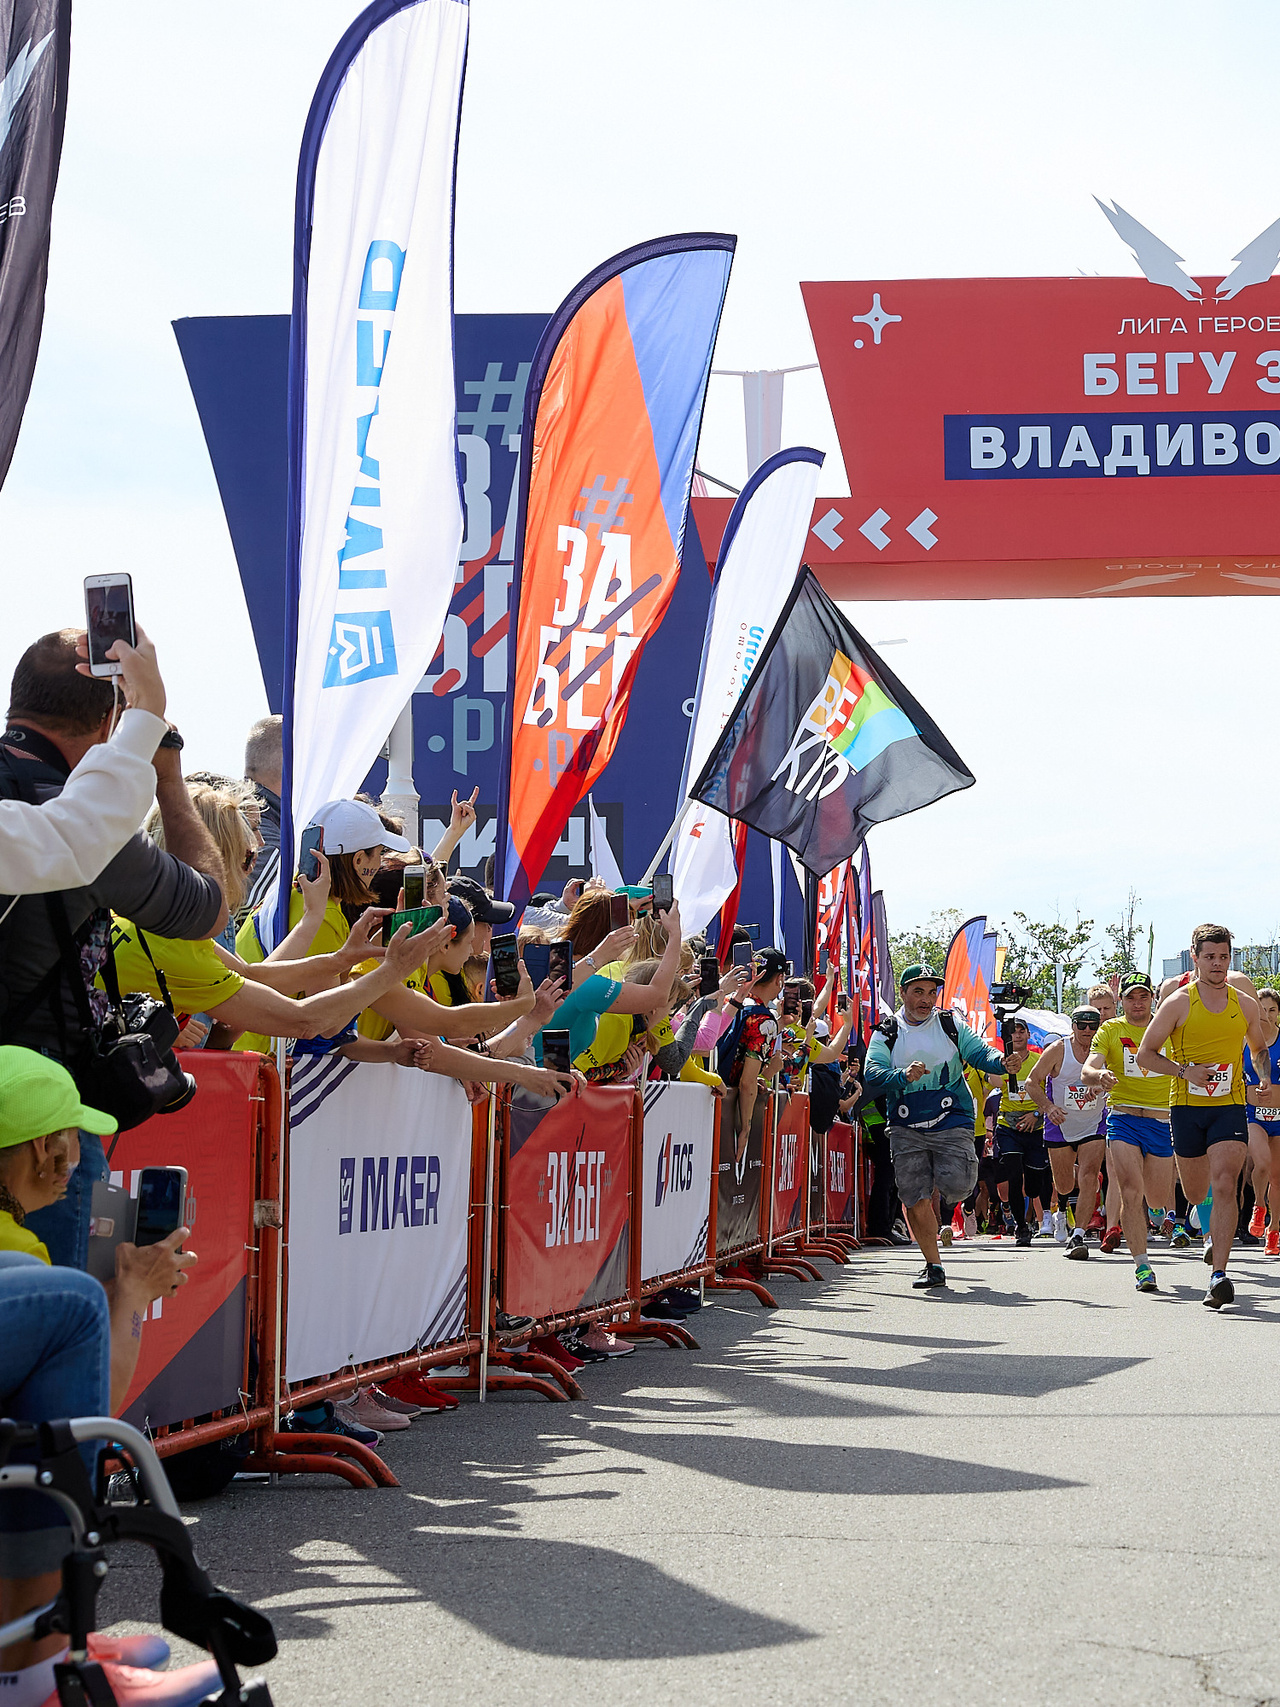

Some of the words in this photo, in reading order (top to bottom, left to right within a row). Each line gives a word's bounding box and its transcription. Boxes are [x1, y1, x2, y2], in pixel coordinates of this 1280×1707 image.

[1117, 317, 1188, 334] ЛИГА
[1083, 350, 1237, 396] БЕГУ
[552, 523, 635, 634] ЗА
[670, 1143, 694, 1193] ПСБ
[360, 1156, 441, 1233] MAER
